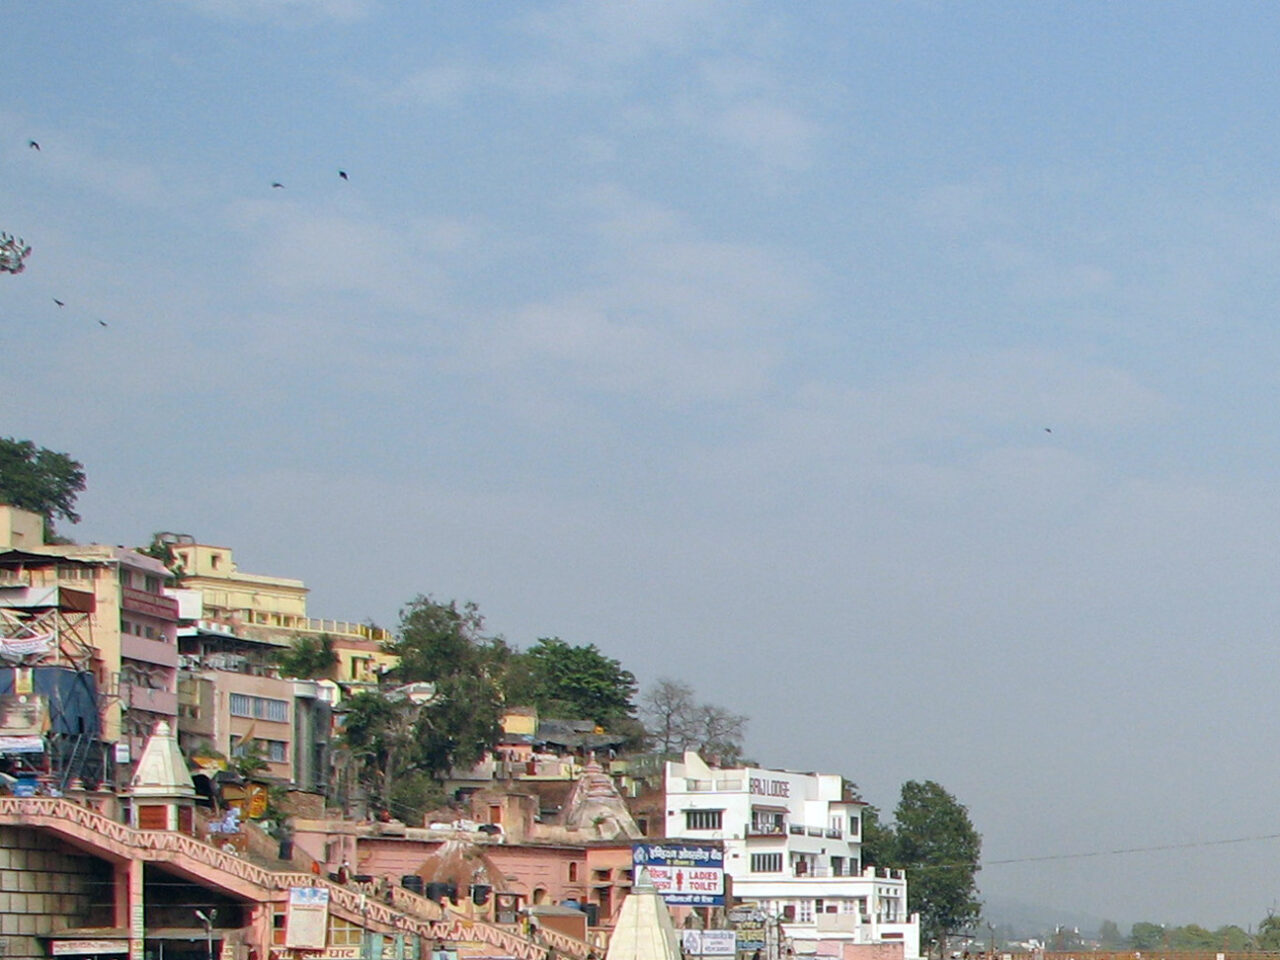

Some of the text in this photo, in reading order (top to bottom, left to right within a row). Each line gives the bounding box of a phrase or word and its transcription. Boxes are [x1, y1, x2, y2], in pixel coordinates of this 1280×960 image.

[767, 779, 790, 798] LODGE
[689, 871, 718, 880] LADIES
[689, 882, 718, 891] TOILET
